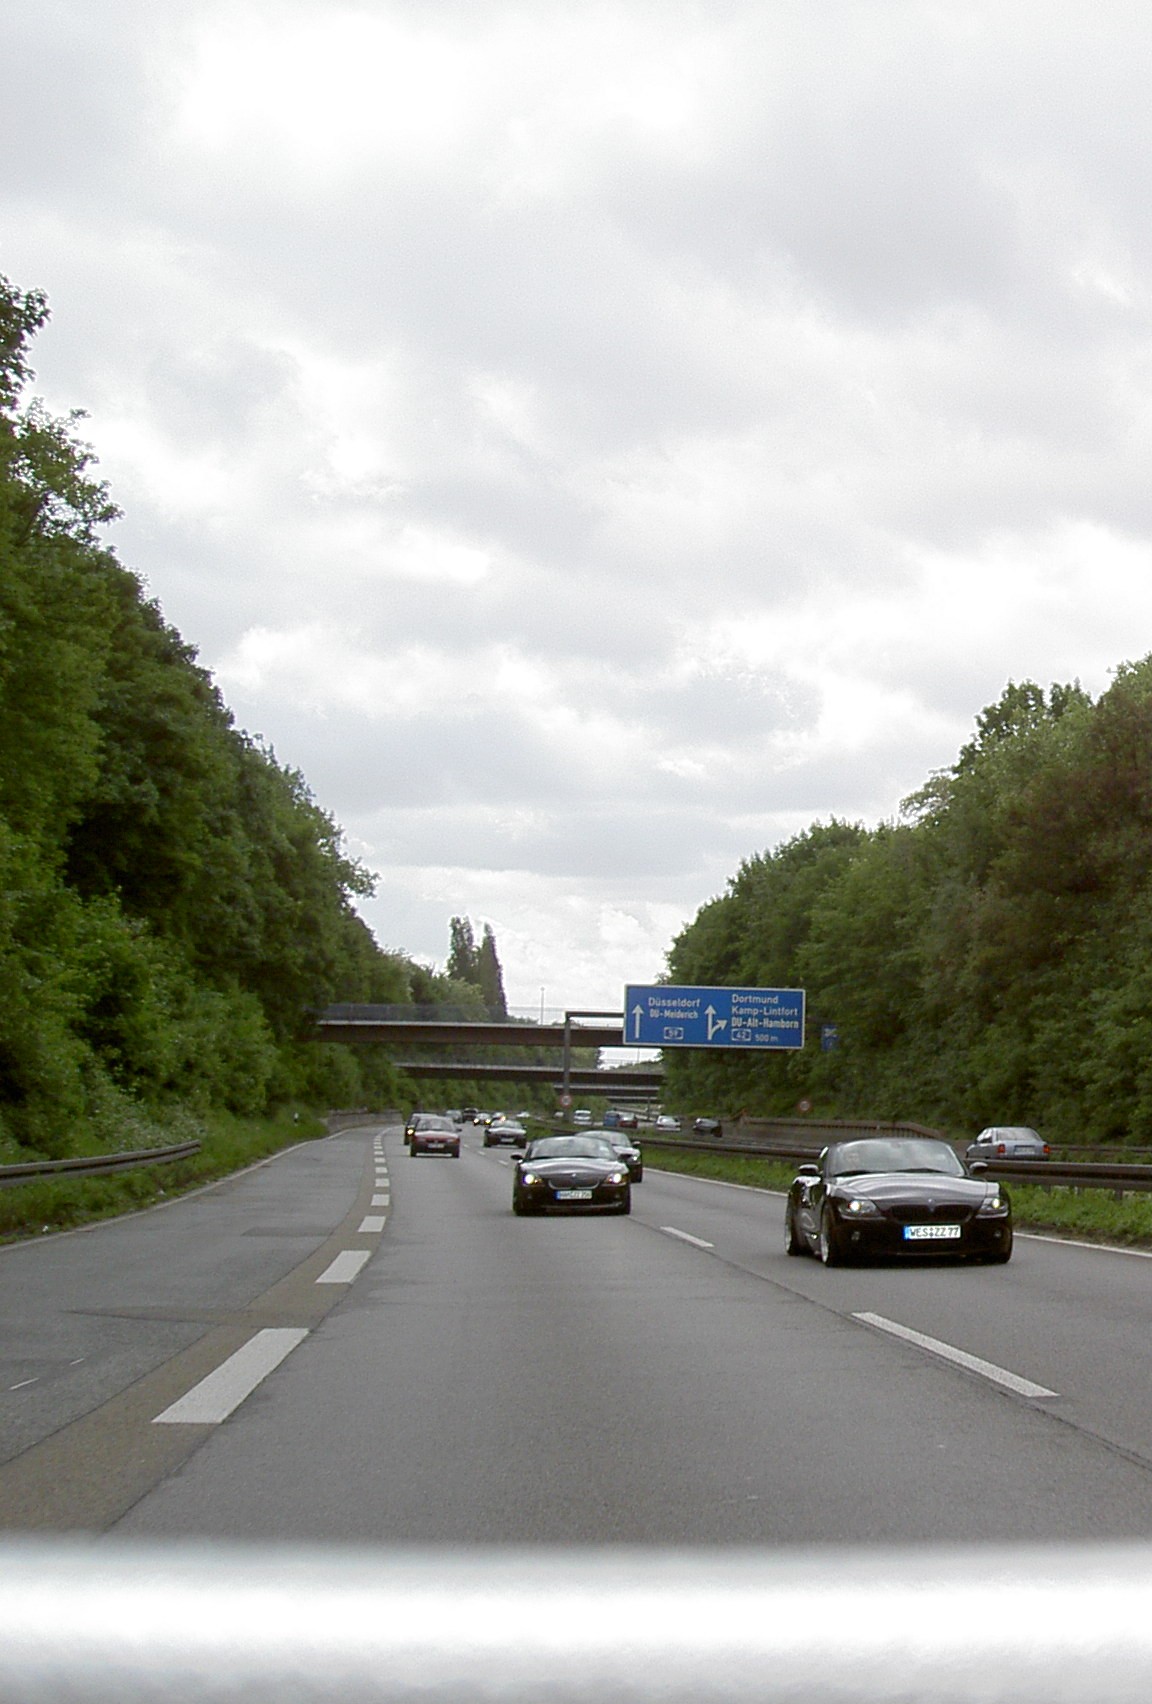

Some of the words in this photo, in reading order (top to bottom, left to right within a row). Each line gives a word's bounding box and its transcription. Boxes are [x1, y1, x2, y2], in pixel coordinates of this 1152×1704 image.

[648, 997, 701, 1007] Düsseldorf
[731, 993, 779, 1004] Dortmund
[649, 1008, 699, 1019] DU-Meiderich
[731, 1006, 798, 1016] Kamp-Lintfort
[731, 1017, 799, 1029] DU-Alt-Hamborn
[735, 1030, 746, 1039] 42
[754, 1033, 769, 1042] 500
[909, 1227, 929, 1238] WES
